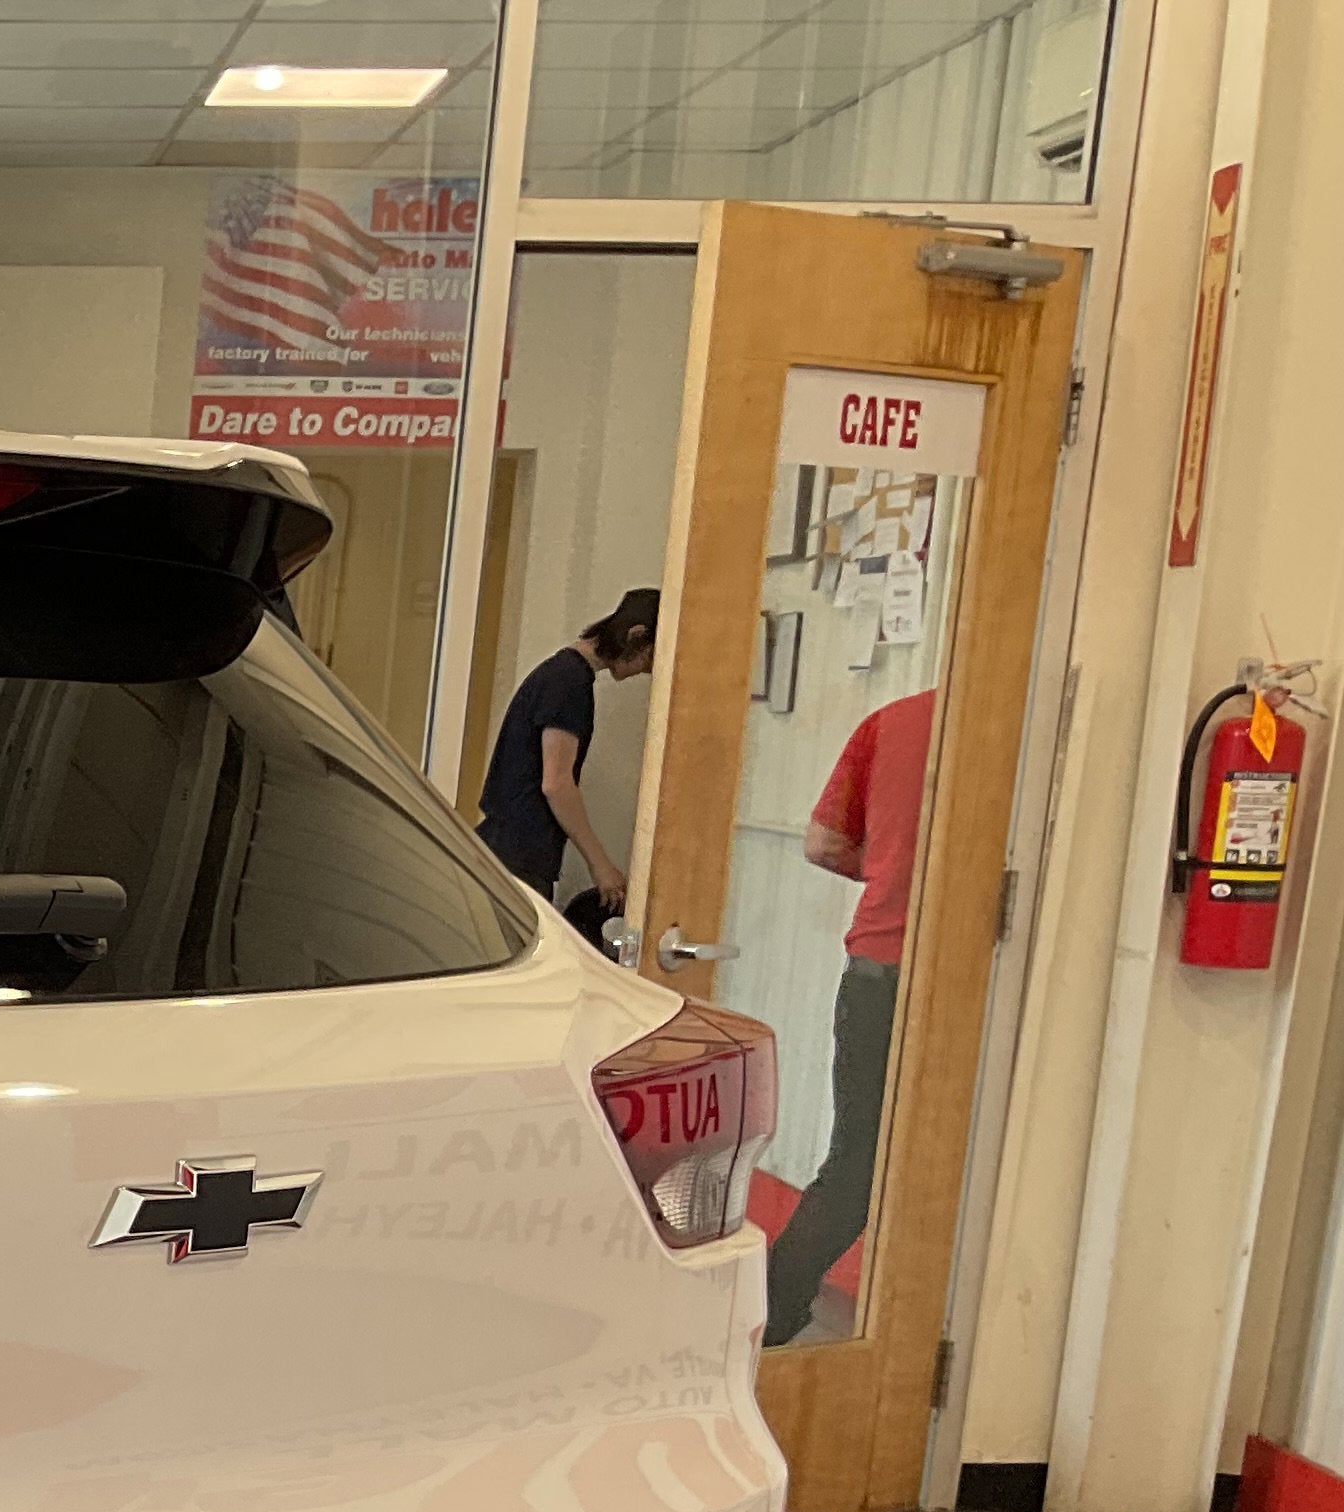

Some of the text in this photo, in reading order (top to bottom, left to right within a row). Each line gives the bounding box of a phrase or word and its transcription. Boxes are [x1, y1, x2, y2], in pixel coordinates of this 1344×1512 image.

[326, 326, 358, 341] Our
[208, 346, 269, 363] factory
[275, 347, 337, 361] trained
[340, 347, 370, 366] for
[198, 405, 277, 436] Dare
[288, 407, 323, 436] to
[840, 393, 922, 450] CAFE
